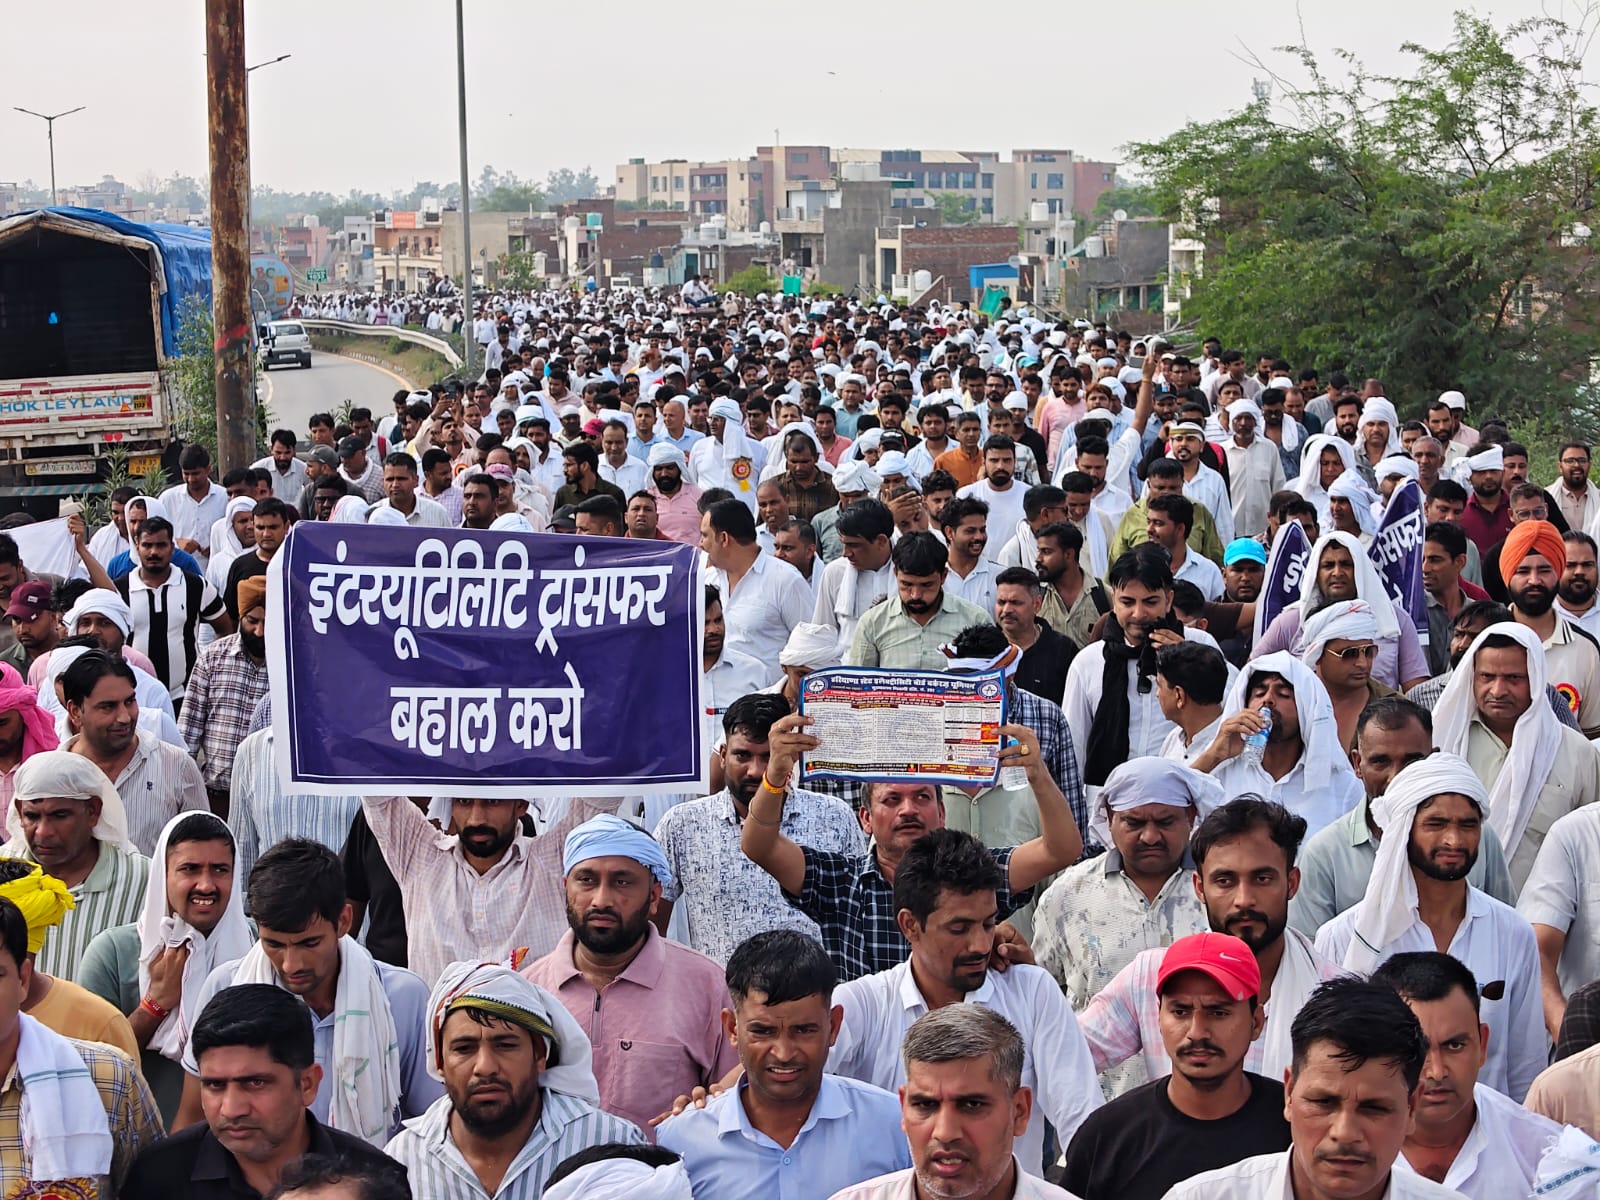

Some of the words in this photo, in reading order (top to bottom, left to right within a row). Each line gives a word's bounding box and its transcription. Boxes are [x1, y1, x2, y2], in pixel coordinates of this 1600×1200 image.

[45, 395, 133, 410] LEYLAND
[535, 545, 673, 656] ट्रांसफर
[390, 687, 501, 756] बहाल
[508, 662, 584, 751] करो
